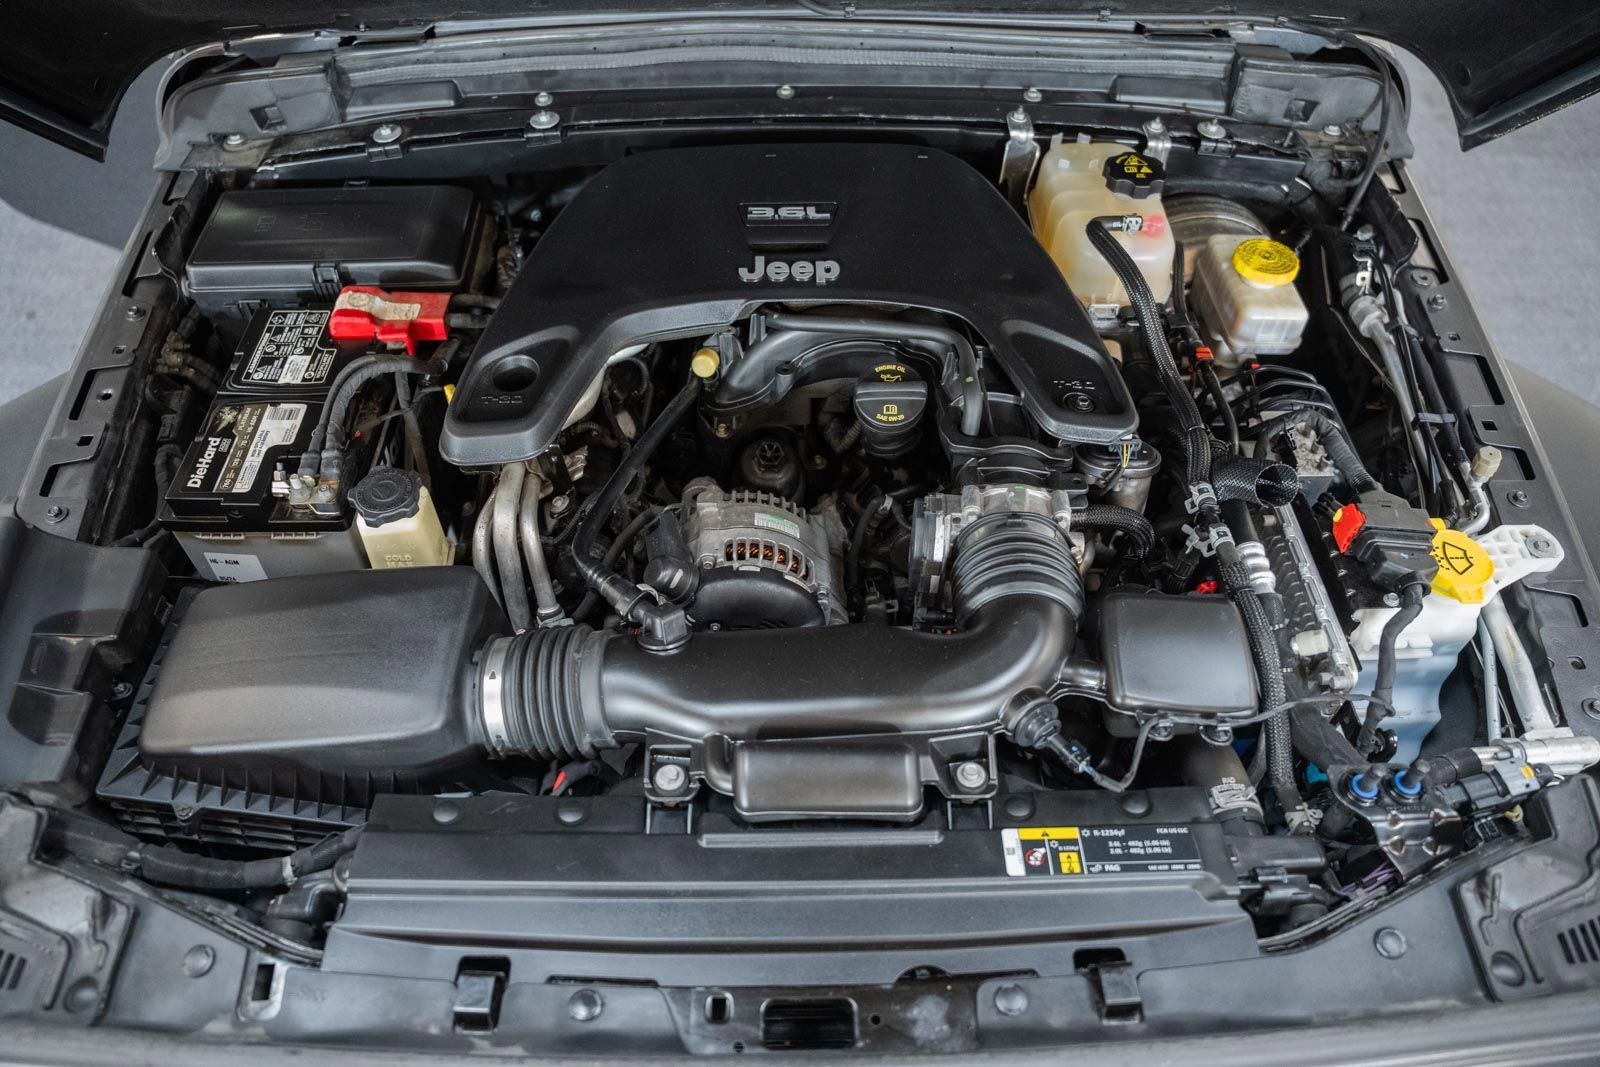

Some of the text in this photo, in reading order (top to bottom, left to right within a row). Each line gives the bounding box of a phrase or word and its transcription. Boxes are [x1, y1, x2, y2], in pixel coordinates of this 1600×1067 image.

[747, 206, 830, 220] 3.6L
[738, 256, 840, 285] Jeep
[875, 364, 897, 373] ENGINE
[238, 408, 252, 431] PLATINUM
[876, 413, 888, 421] SAE
[187, 436, 222, 488] DieHard
[1093, 828, 1125, 837] R-1234yf
[1104, 864, 1121, 872] PAG
